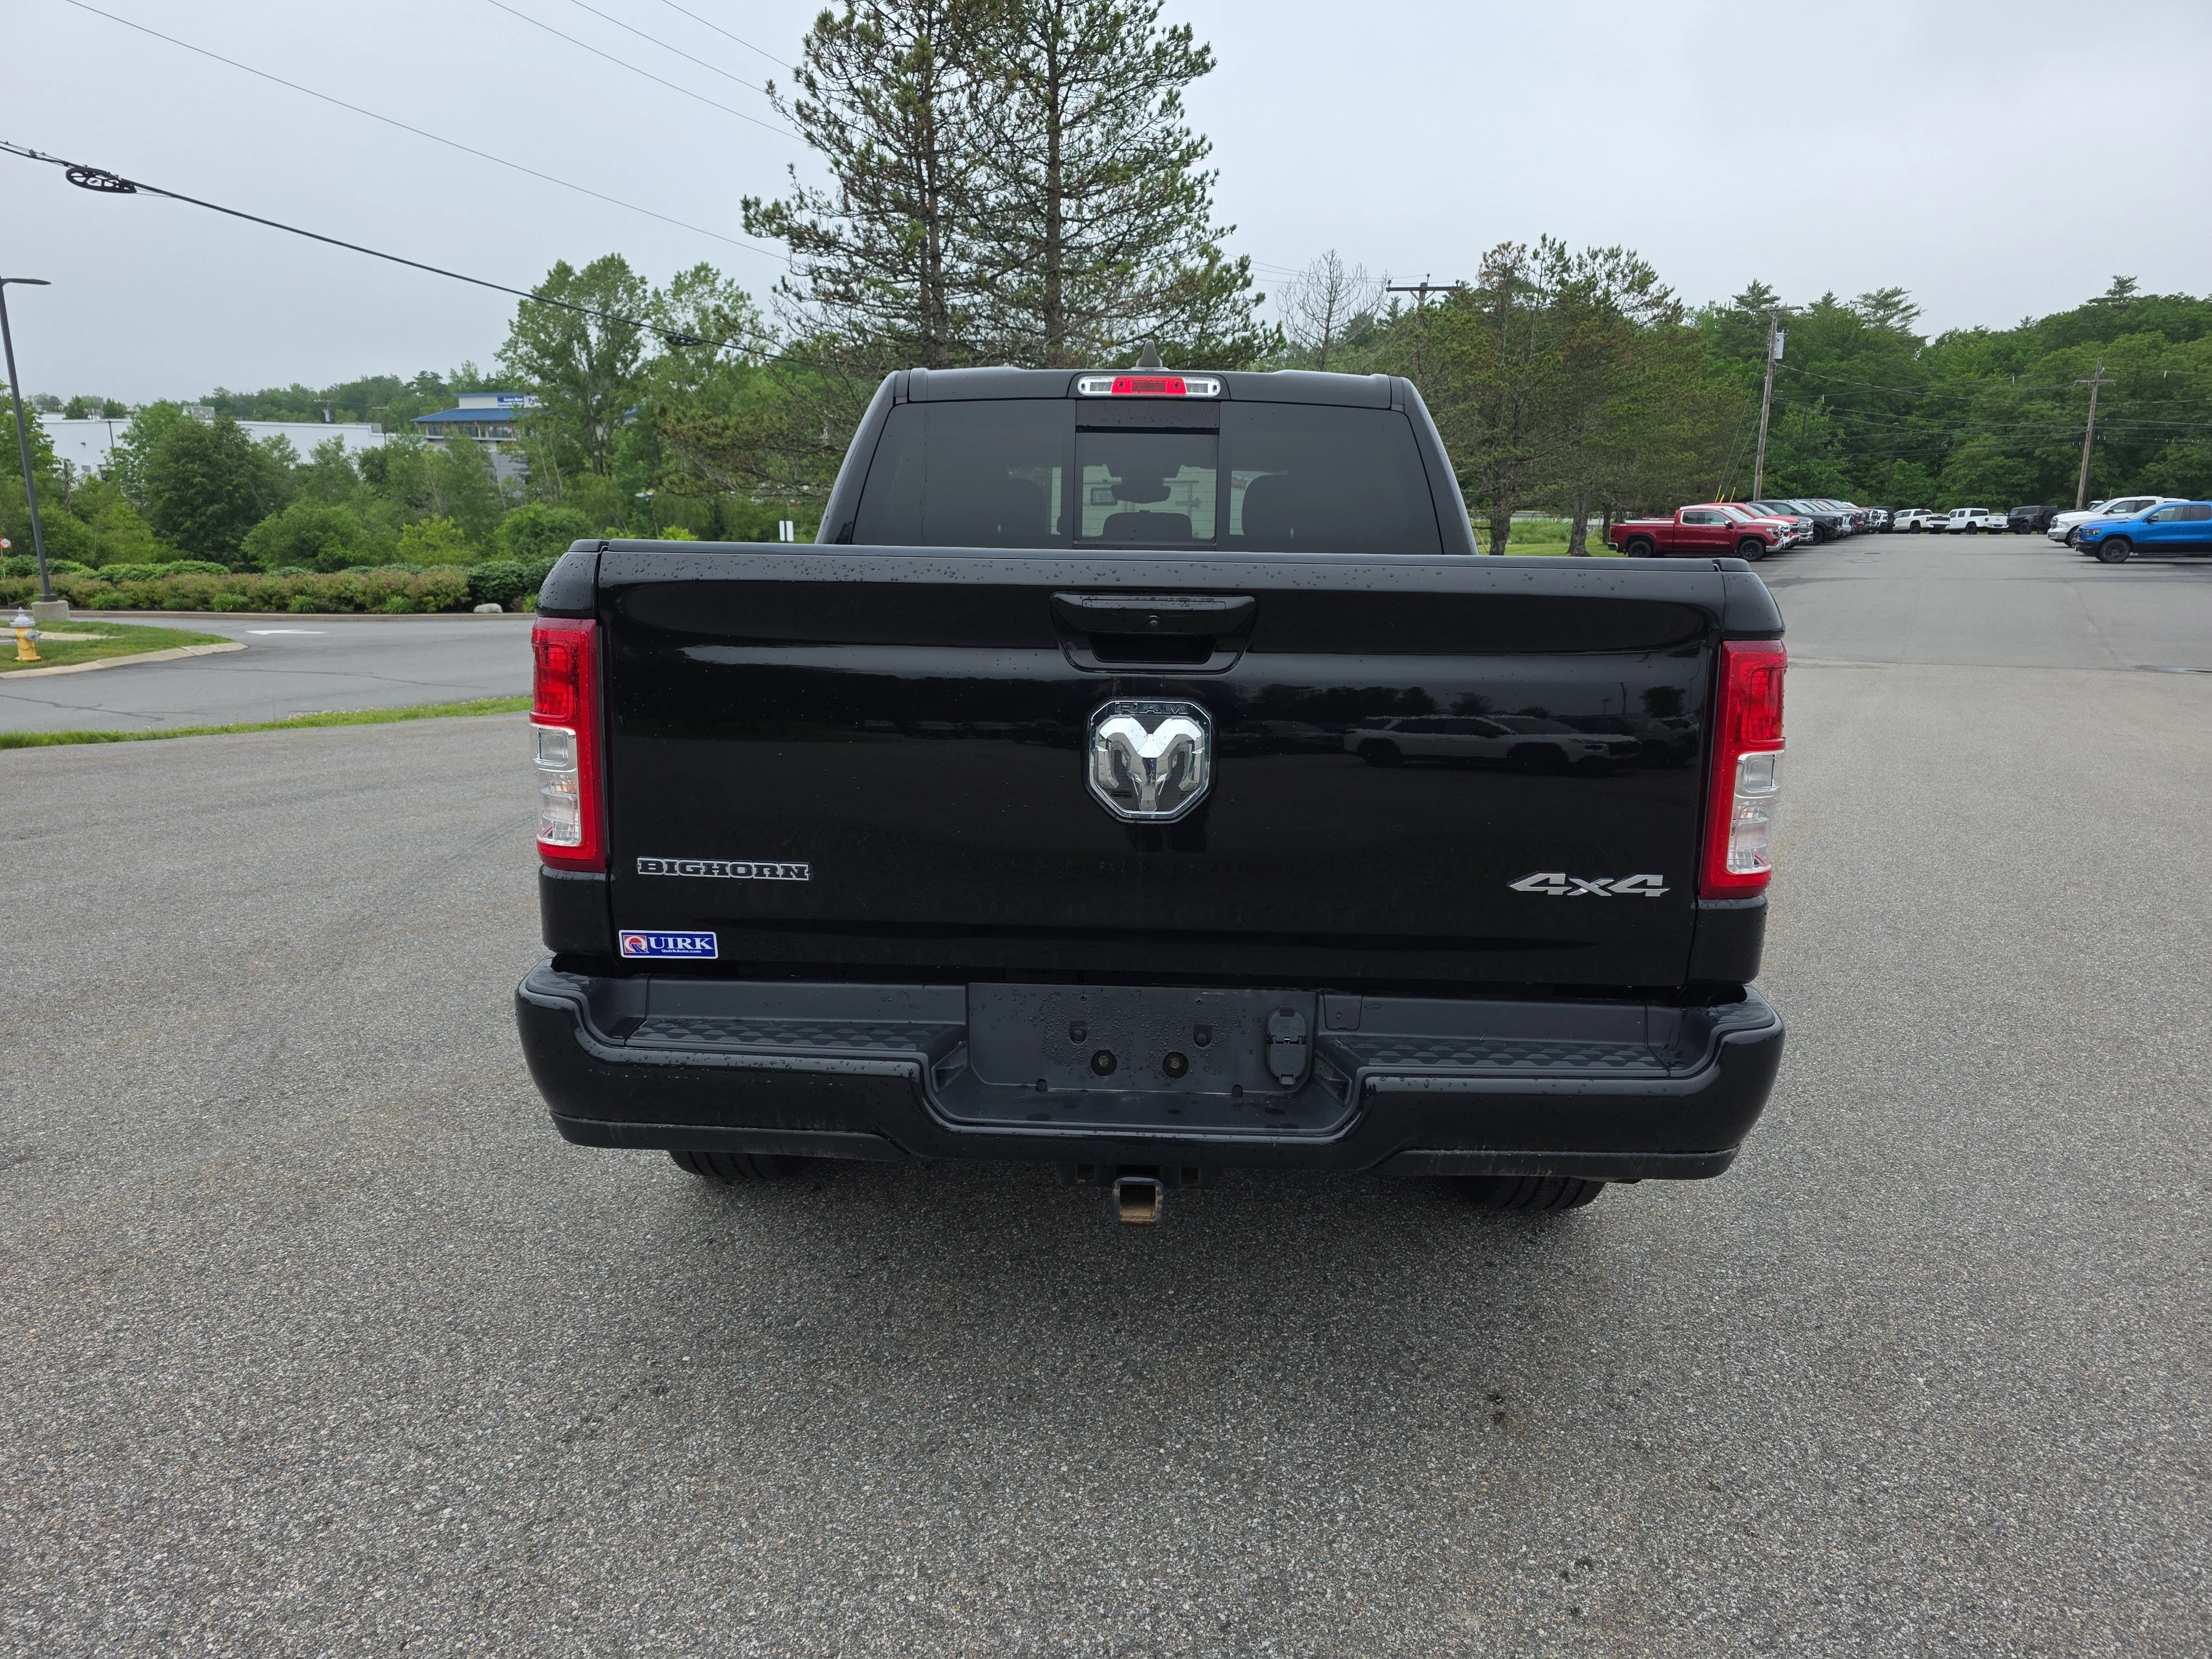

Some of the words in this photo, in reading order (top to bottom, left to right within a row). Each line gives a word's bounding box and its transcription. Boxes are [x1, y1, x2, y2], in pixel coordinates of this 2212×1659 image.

[1115, 703, 1188, 714] RAM
[637, 857, 811, 881] BIGHORN
[623, 935, 713, 953] QUIRK
